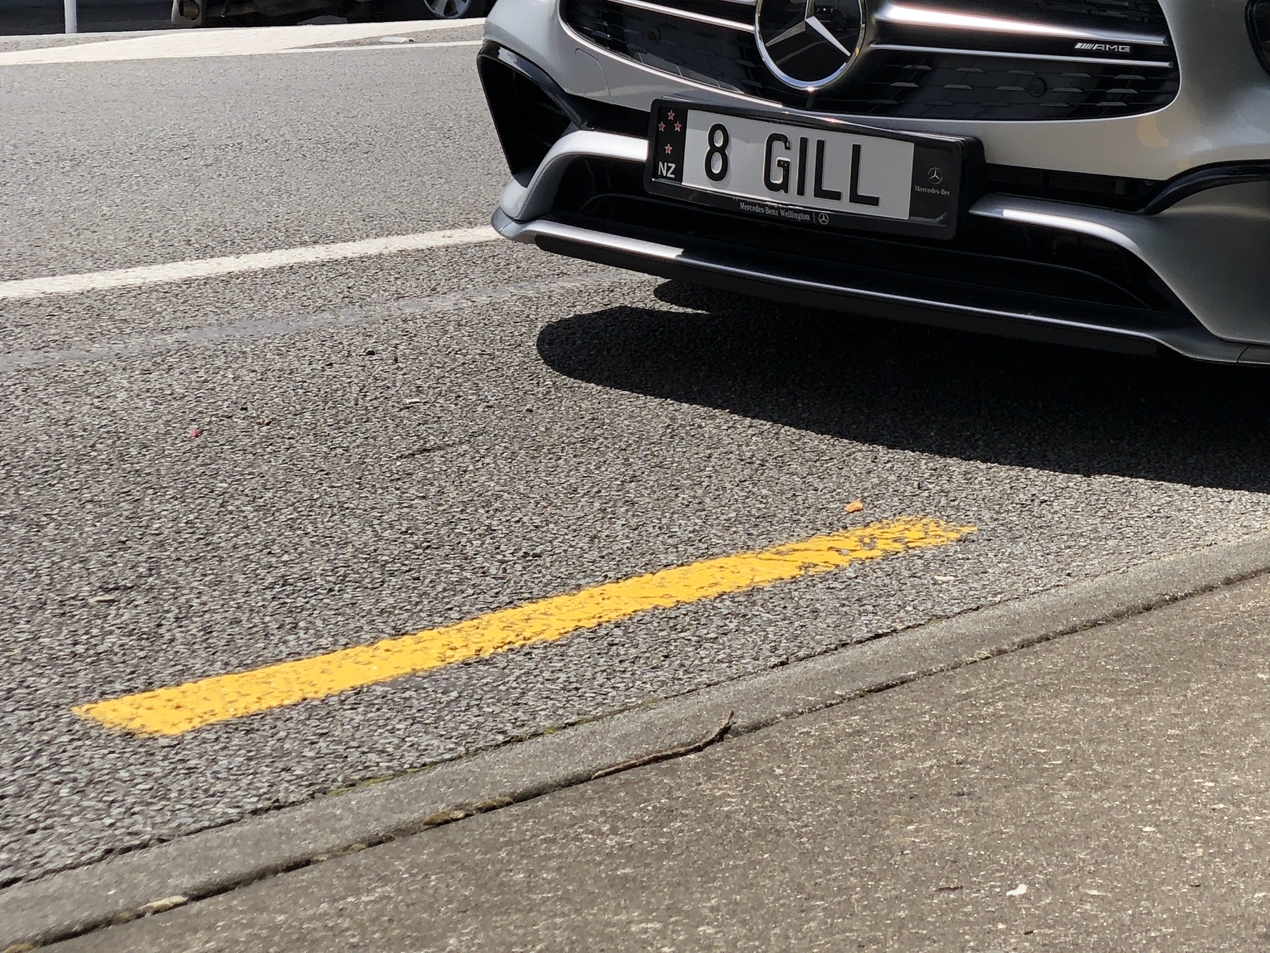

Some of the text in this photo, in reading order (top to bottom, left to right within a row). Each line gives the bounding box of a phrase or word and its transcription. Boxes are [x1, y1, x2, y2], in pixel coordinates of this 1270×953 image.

[1092, 43, 1131, 53] AMG
[657, 160, 677, 179] NZ
[704, 123, 881, 207] 8 GILL
[739, 202, 811, 222] Mercedes-Benz Wellington
